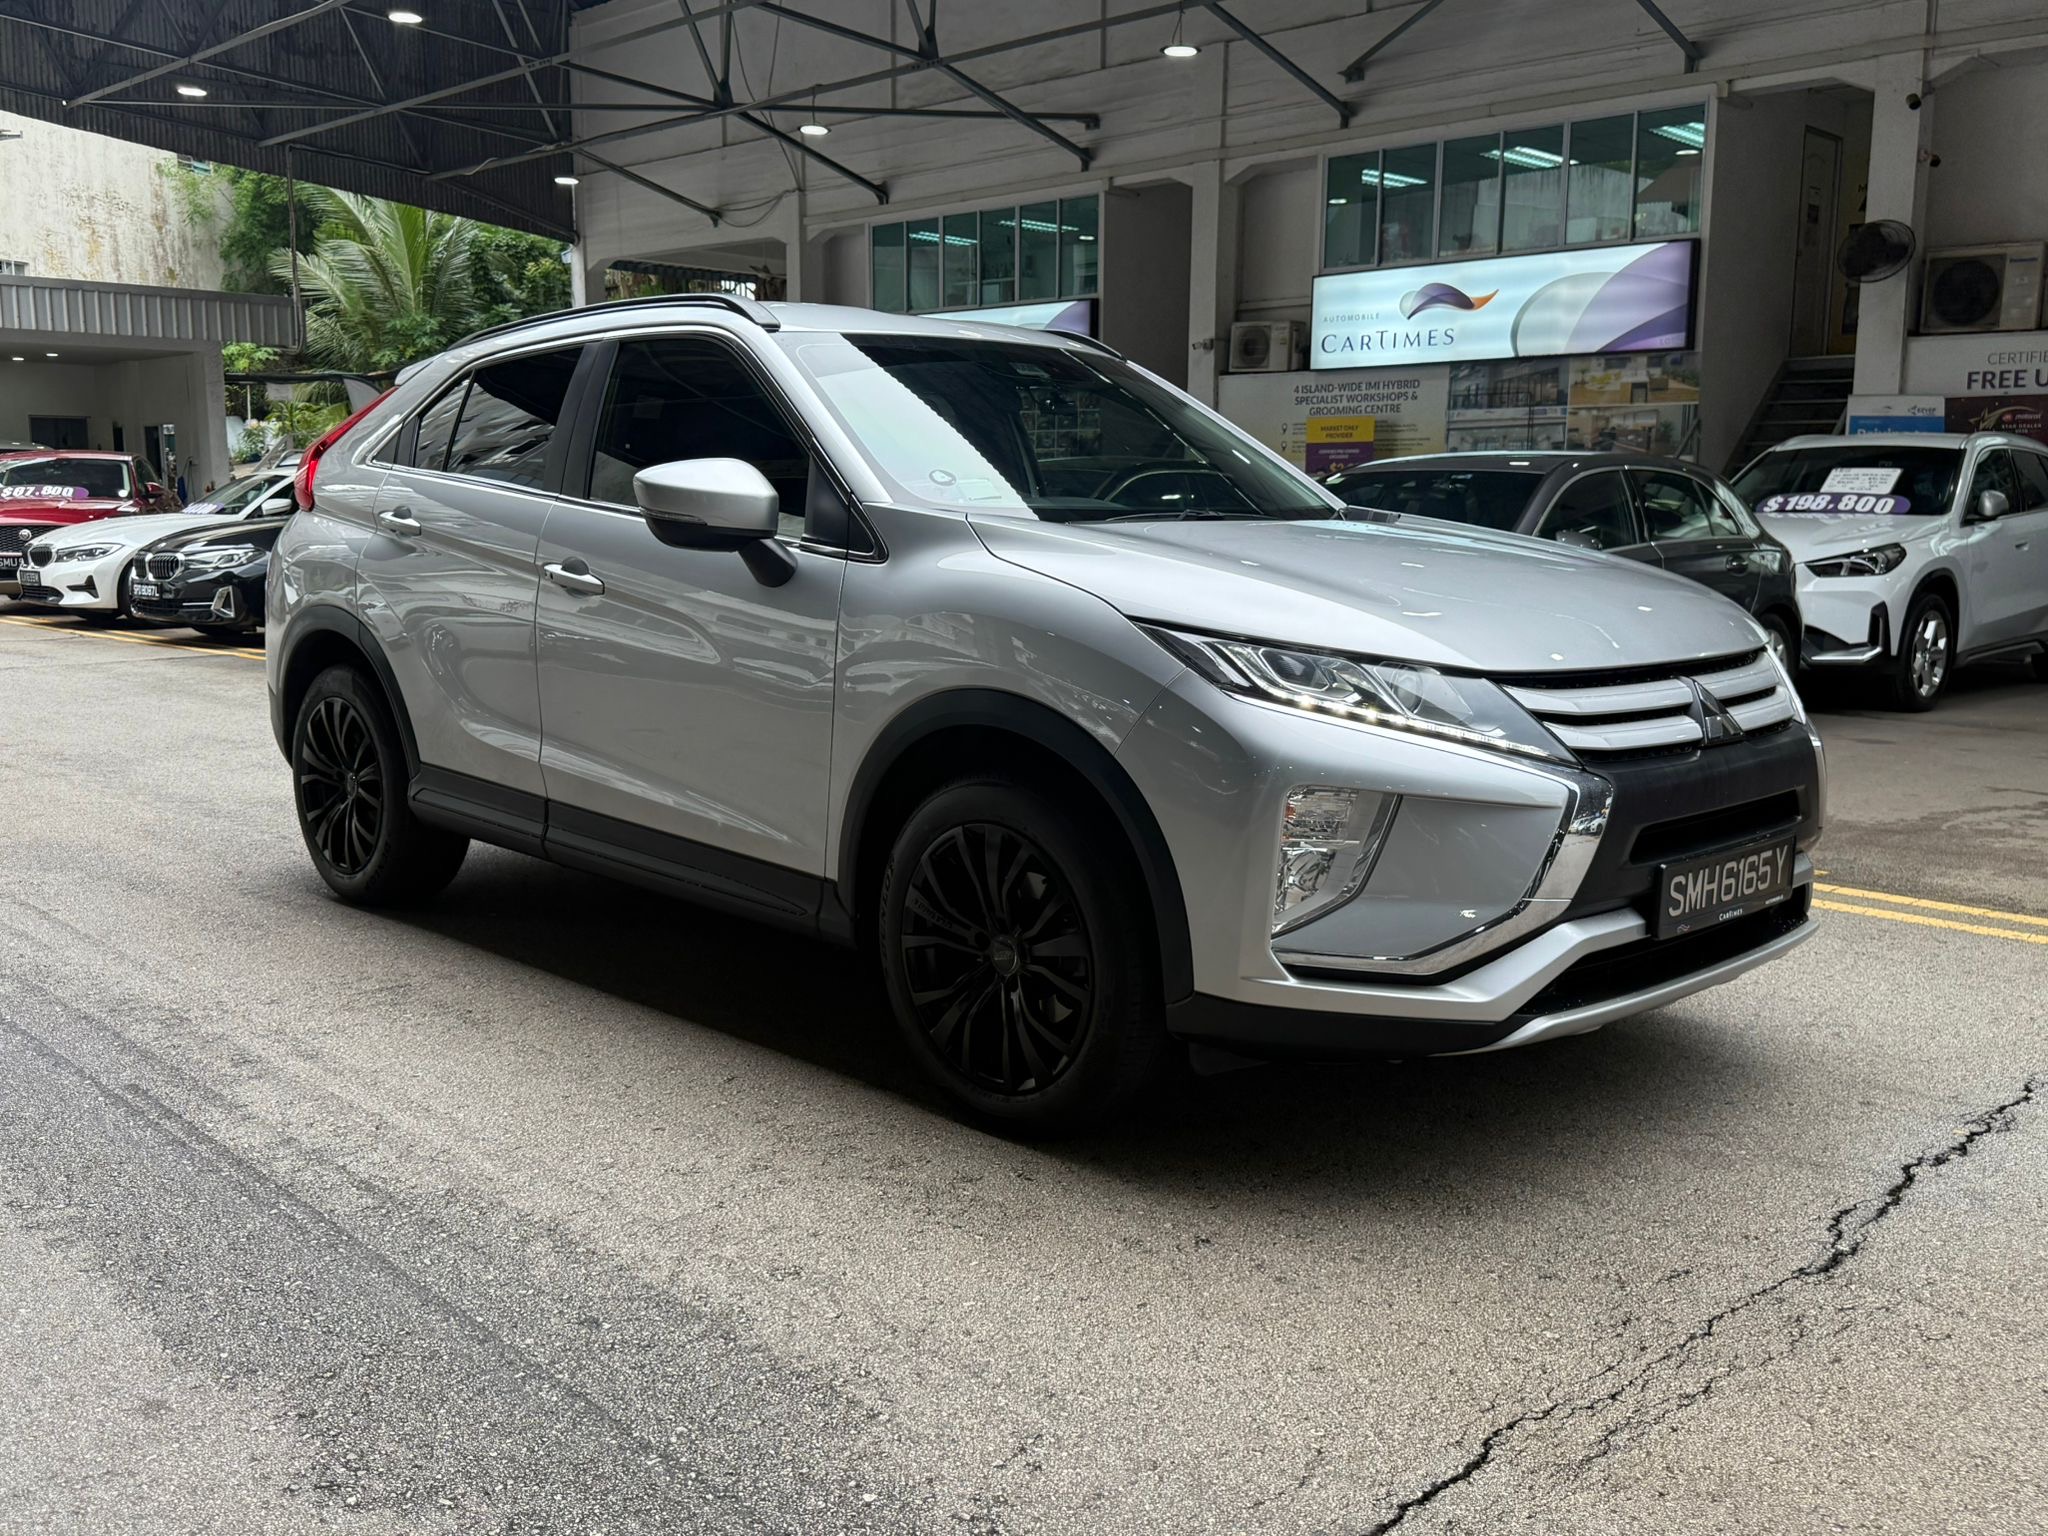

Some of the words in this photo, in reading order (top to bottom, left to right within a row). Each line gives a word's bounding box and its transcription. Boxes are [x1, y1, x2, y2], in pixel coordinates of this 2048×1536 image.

[1323, 312, 1380, 323] AUTOMOBILE
[1293, 384, 1300, 394] 4
[1301, 382, 1363, 394] ISLAND-WIDE
[1382, 379, 1420, 390] HYBRID
[1966, 369, 2028, 390] FREE
[1294, 394, 1344, 406] SPECIALIST
[1346, 391, 1409, 404] WORKSHOPS
[1410, 391, 1418, 401] &
[1309, 405, 1362, 417] GROOMING
[1365, 403, 1402, 415] CENTRE
[1668, 845, 1788, 917] SMH6165Y
